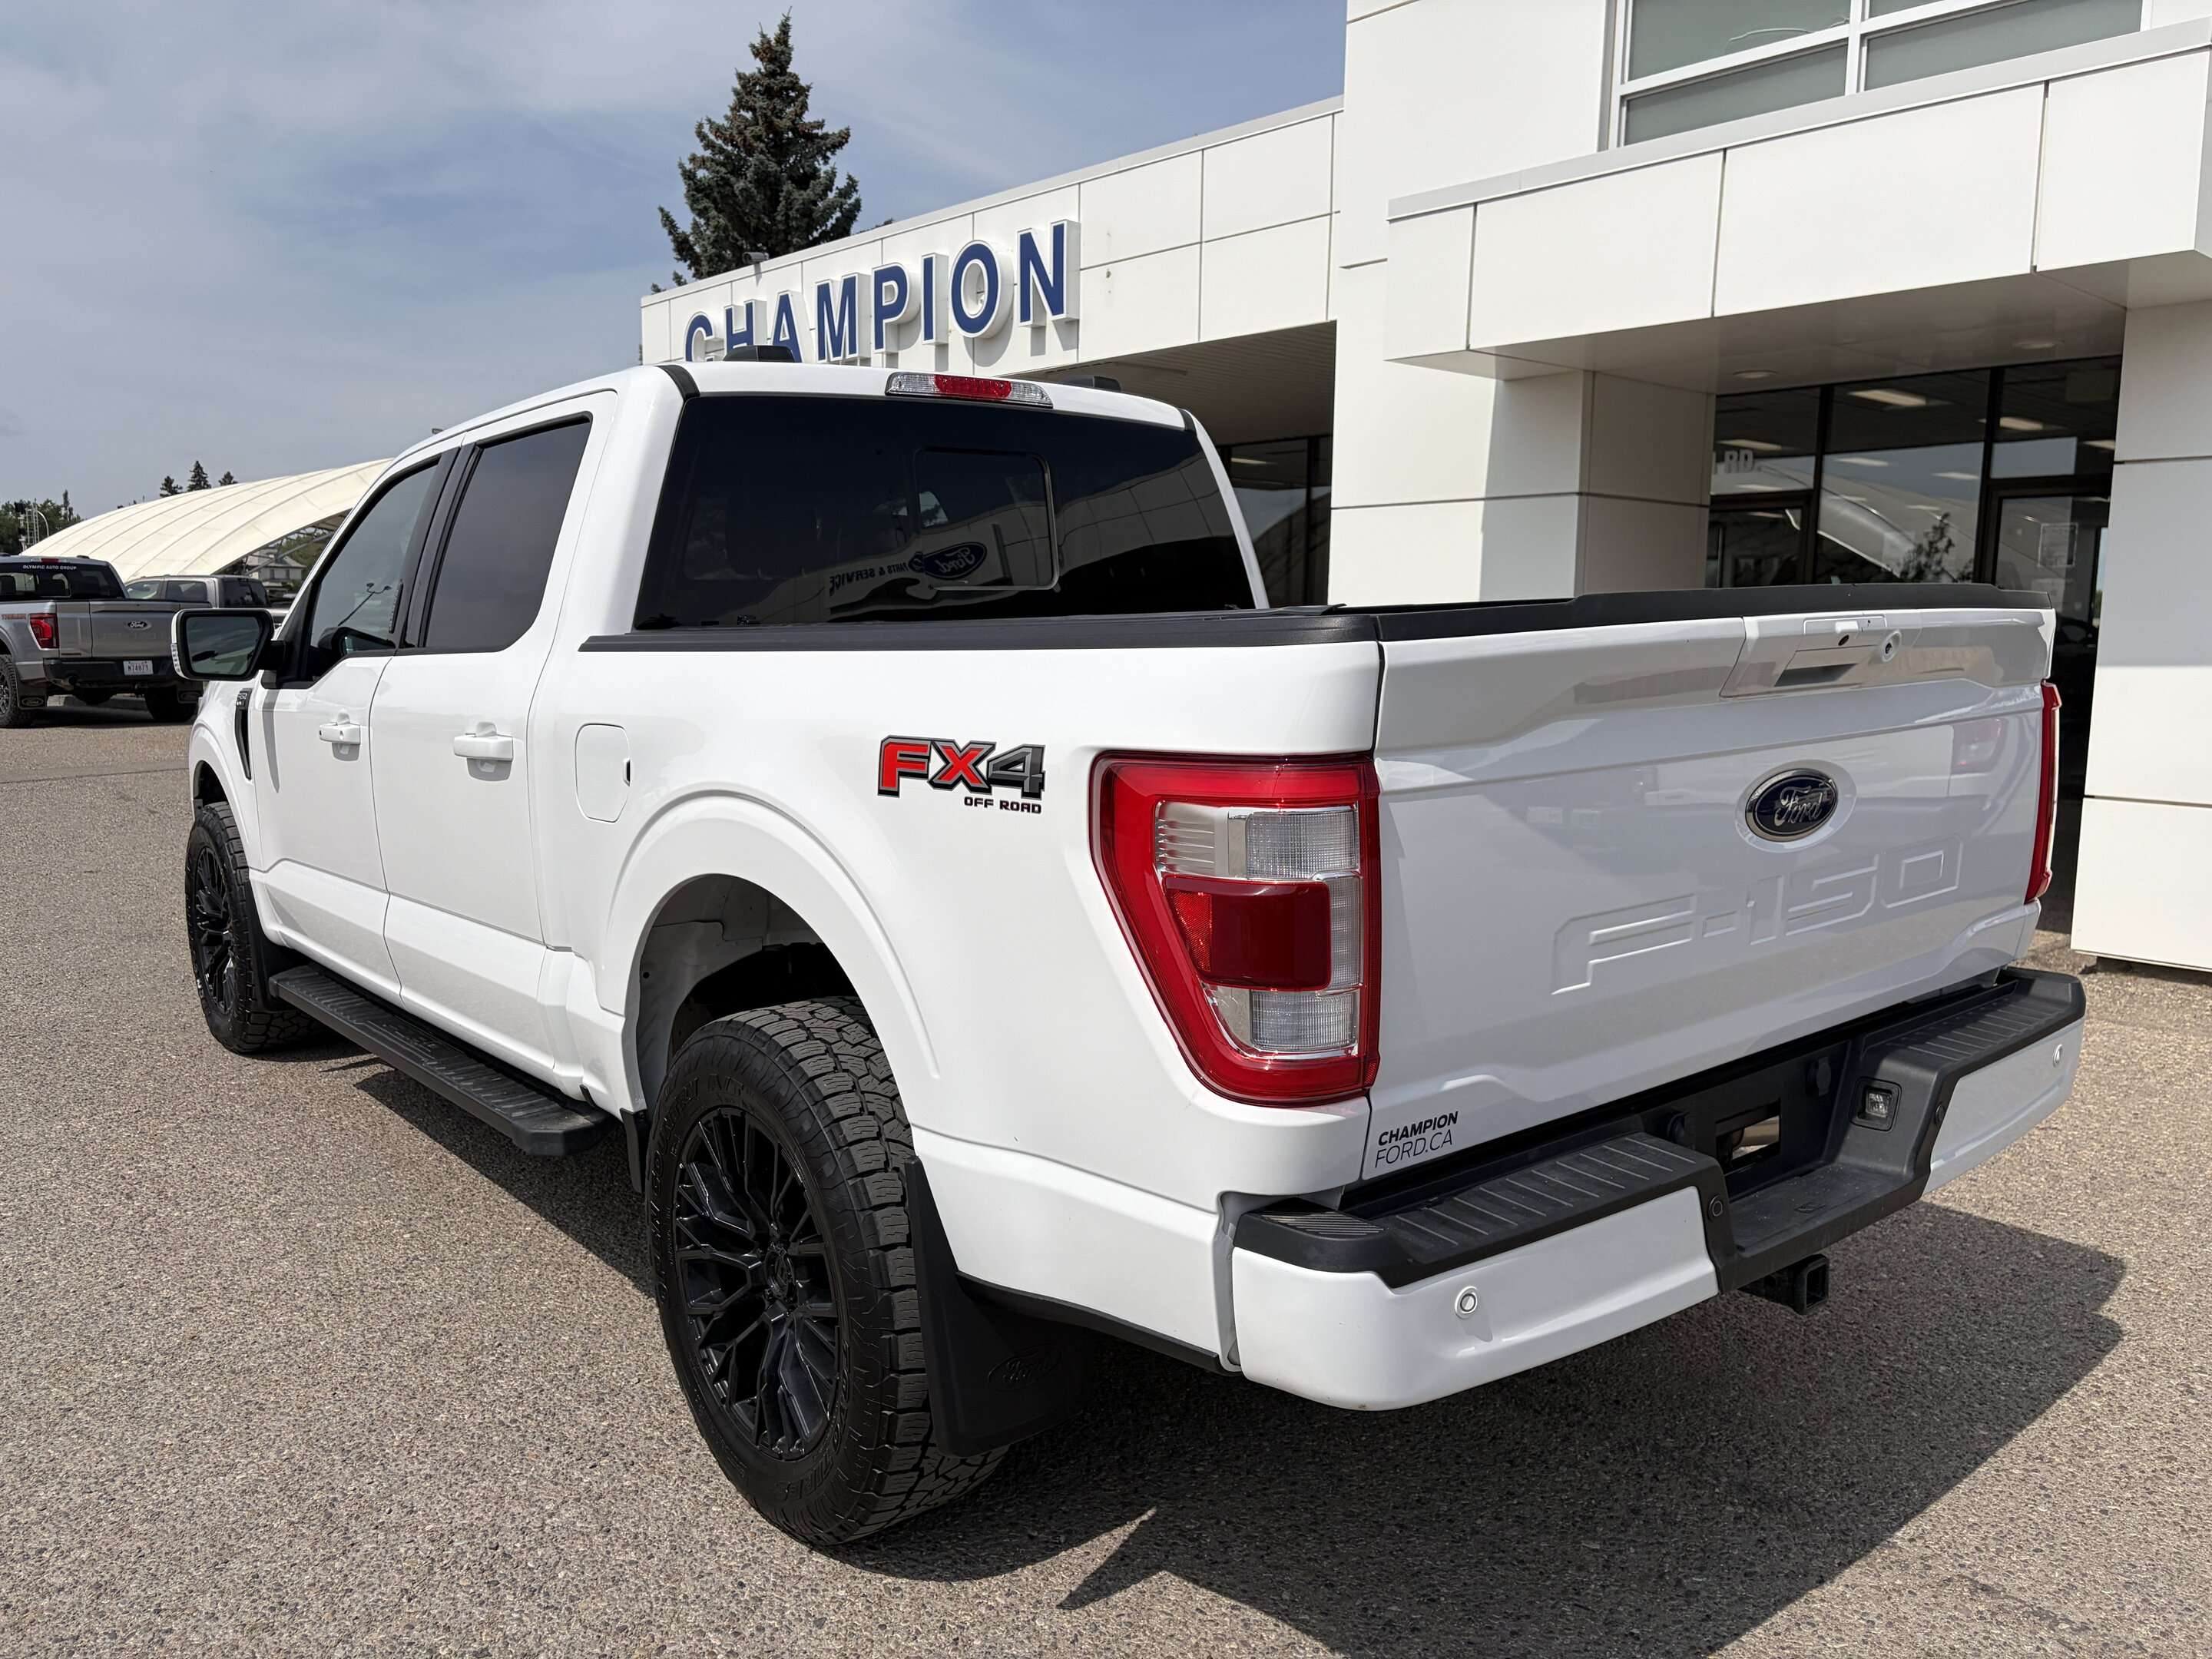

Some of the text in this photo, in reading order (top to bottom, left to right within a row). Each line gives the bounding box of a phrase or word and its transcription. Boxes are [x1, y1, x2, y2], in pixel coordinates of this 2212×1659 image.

[684, 219, 1080, 363] CHAMPION
[878, 735, 1046, 800] FX4
[963, 796, 1042, 815] OFF ROAD
[1773, 784, 1827, 827] Ford
[1551, 834, 1964, 995] F-150
[1375, 1128, 1452, 1169] FORD.CA
[1378, 1111, 1459, 1147] CHAMPION
